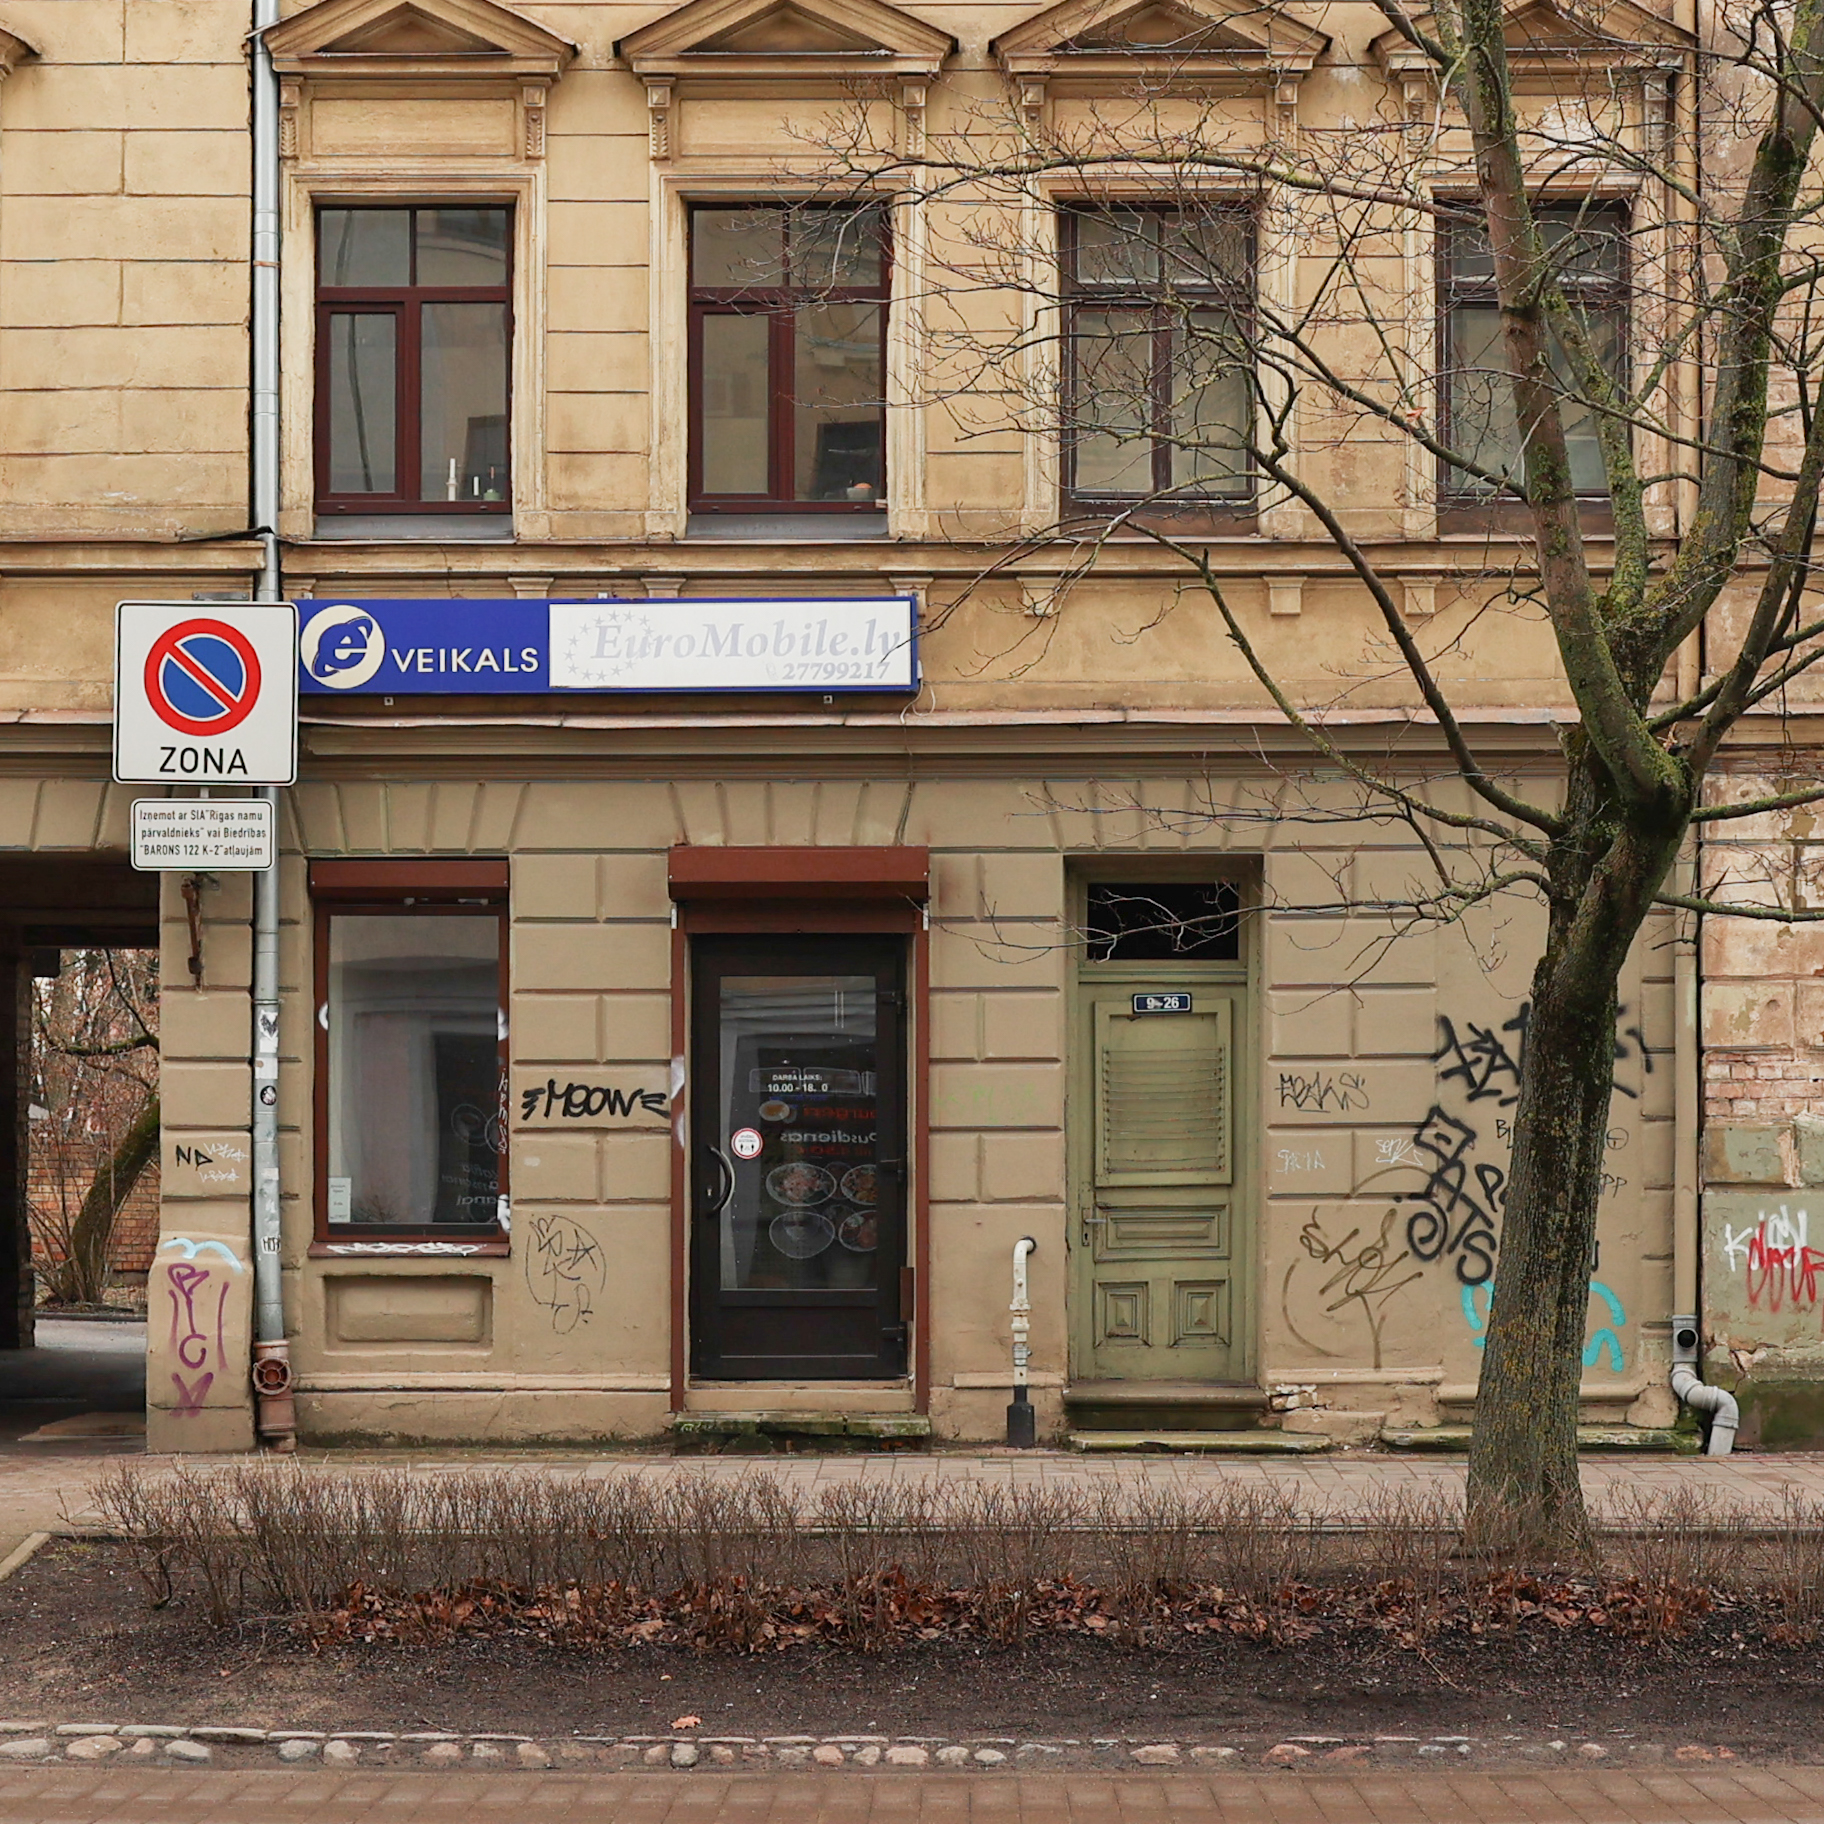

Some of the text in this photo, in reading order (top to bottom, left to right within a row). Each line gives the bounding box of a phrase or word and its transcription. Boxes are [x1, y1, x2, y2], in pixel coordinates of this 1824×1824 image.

[391, 648, 539, 673] VEIKALS
[781, 661, 891, 681] 27799217
[159, 746, 248, 775] ZONA
[178, 812, 188, 820] ar
[237, 811, 263, 821] namu
[207, 829, 221, 838] vai
[184, 844, 199, 855] 122
[768, 1083, 793, 1092] 10.00
